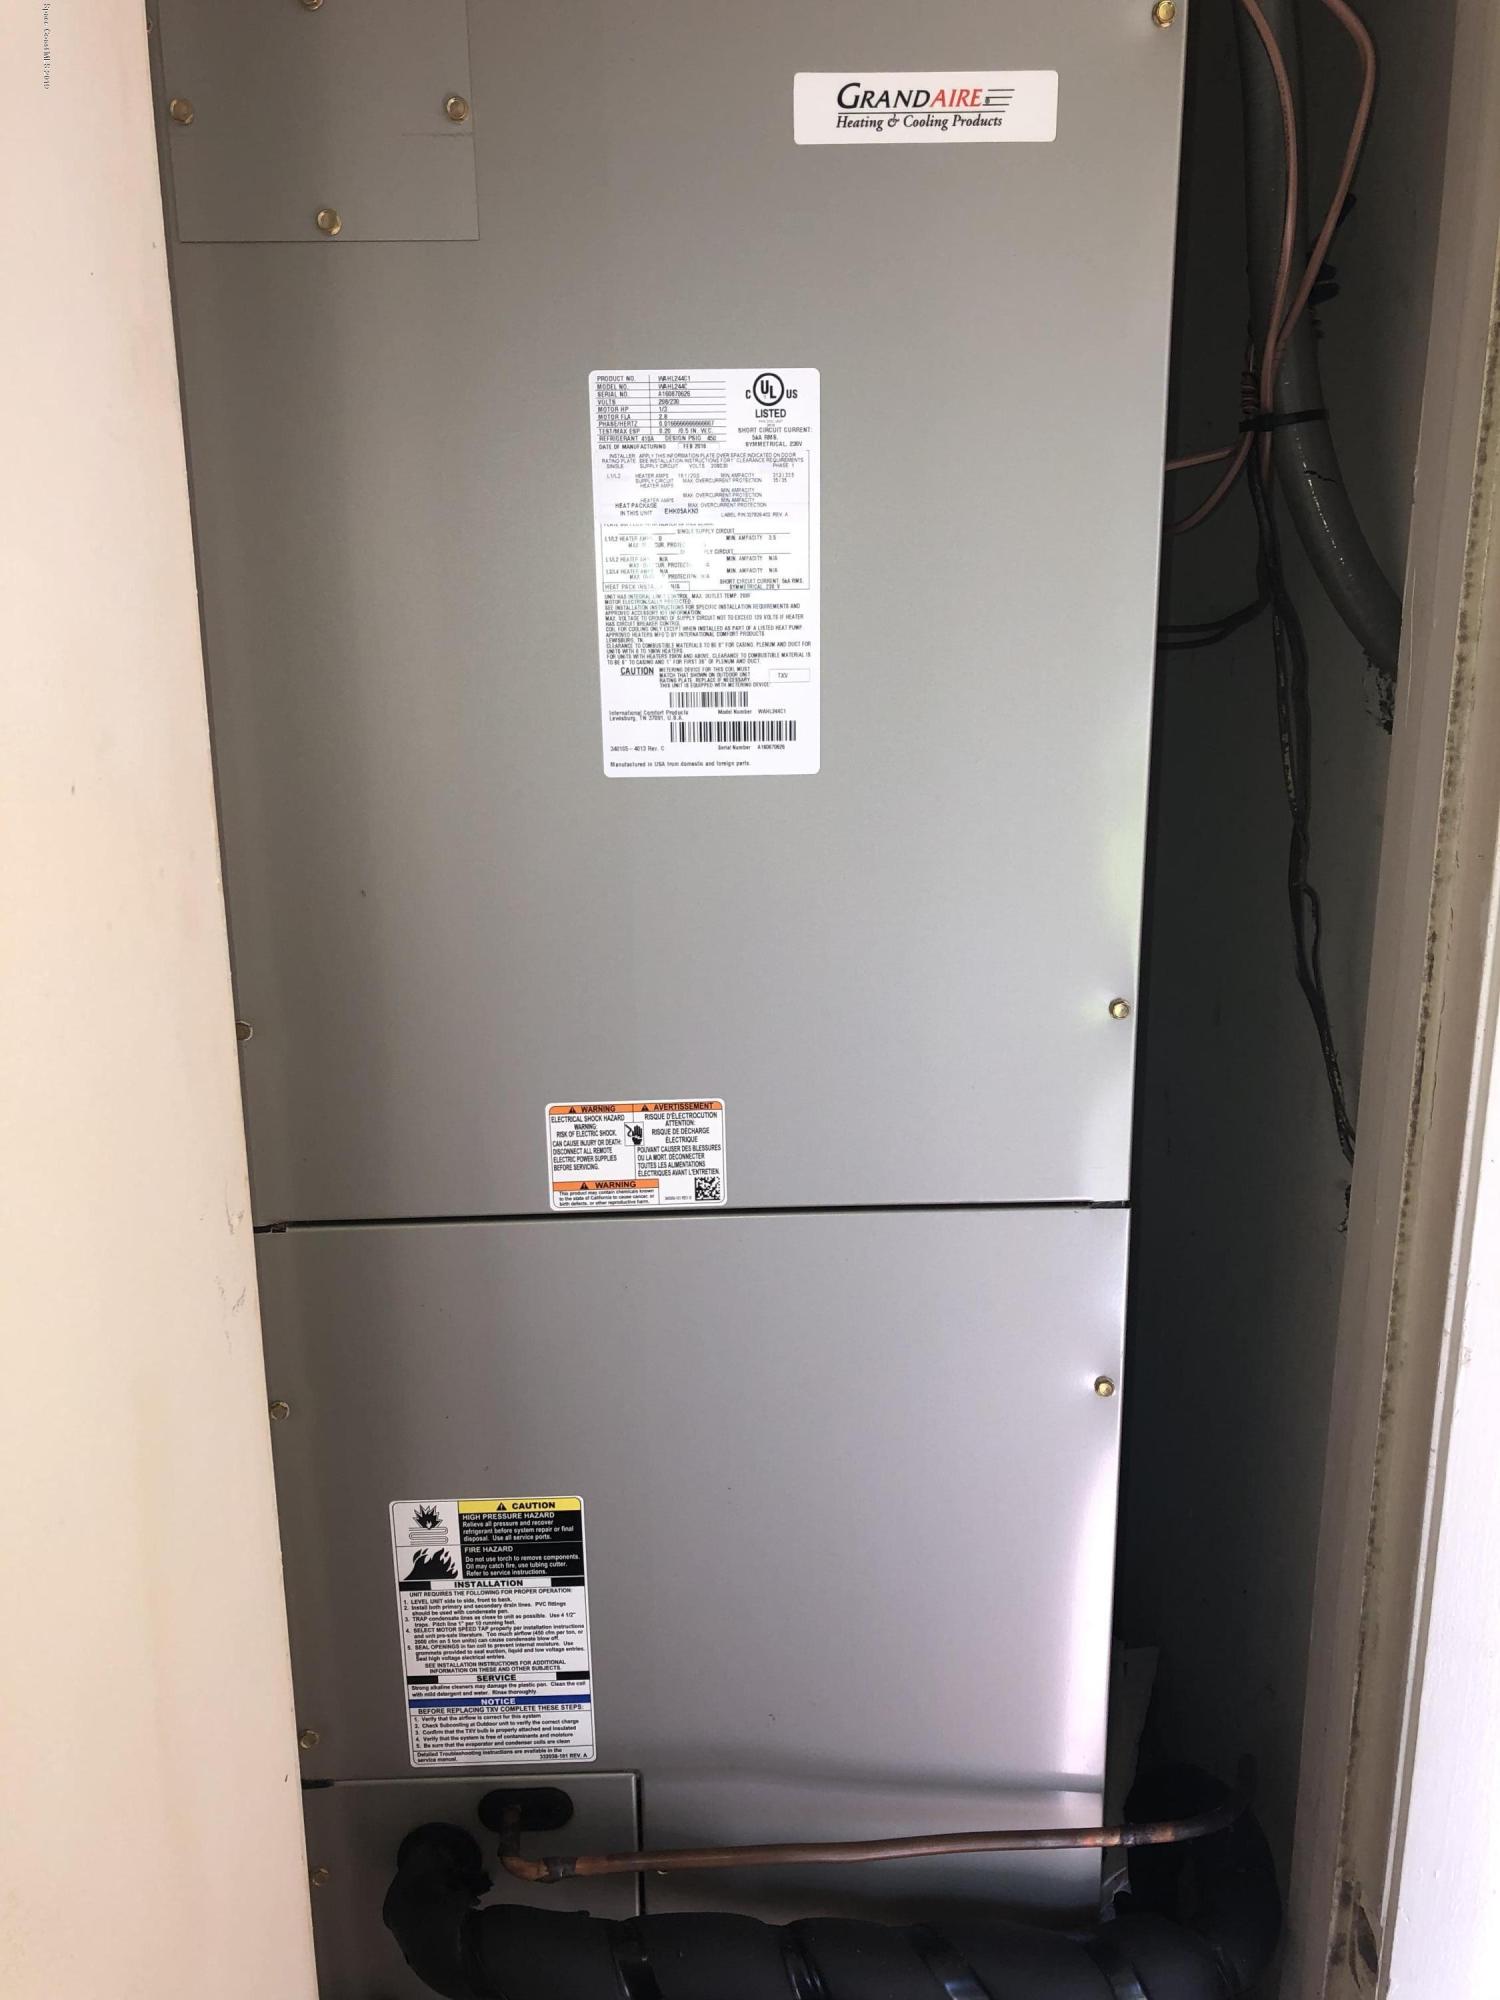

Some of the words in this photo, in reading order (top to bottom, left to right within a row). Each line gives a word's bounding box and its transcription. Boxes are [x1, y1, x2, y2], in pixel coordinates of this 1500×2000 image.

[836, 114, 884, 132] Heating
[887, 113, 900, 128] &
[903, 113, 949, 132] Cooling
[952, 112, 1003, 127] Products
[786, 389, 798, 399] US
[755, 408, 787, 418] LISTED
[620, 667, 654, 675] CAUTION
[581, 1105, 616, 1113] WARNING
[653, 1102, 714, 1111] AVERTISSEMENT
[551, 1115, 583, 1123] ELECTRICAL
[661, 1145, 681, 1153] CAUSER
[692, 1144, 722, 1152] BLESSURES
[668, 1160, 706, 1168] ALIMENTATIONS
[595, 1180, 637, 1189] WARNING
[512, 1501, 556, 1510] CAUTION
[493, 1520, 518, 1528] pressure
[463, 1528, 493, 1536] refrigerant
[514, 1527, 534, 1535] system
[536, 1526, 552, 1534] repair
[529, 1561, 548, 1569] tubing
[454, 1580, 524, 1589] INSTALLATION
[476, 1674, 517, 1682] SERVICE
[481, 1698, 516, 1706] NOTICE
[447, 1706, 485, 1714] REPLACING
